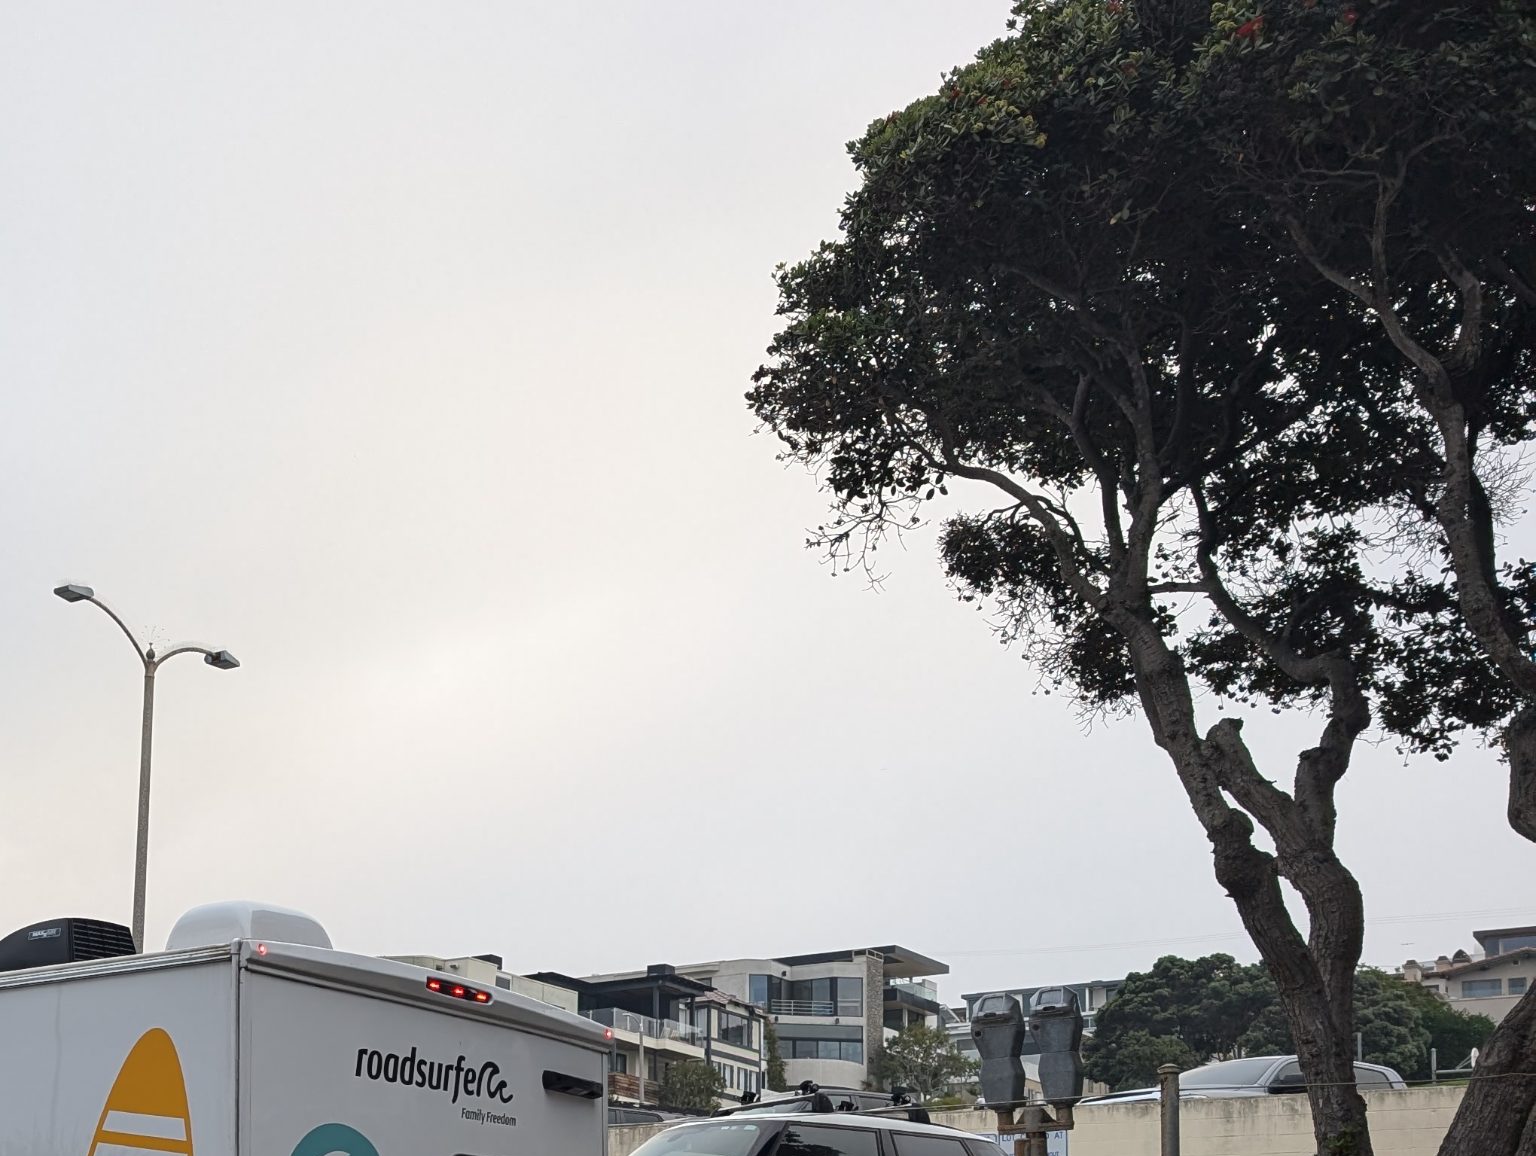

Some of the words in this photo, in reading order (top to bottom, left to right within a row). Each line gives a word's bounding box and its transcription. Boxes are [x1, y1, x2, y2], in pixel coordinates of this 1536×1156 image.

[355, 1047, 514, 1105] roadsurfer
[461, 1108, 485, 1125] Family
[486, 1111, 517, 1127] Freedom
